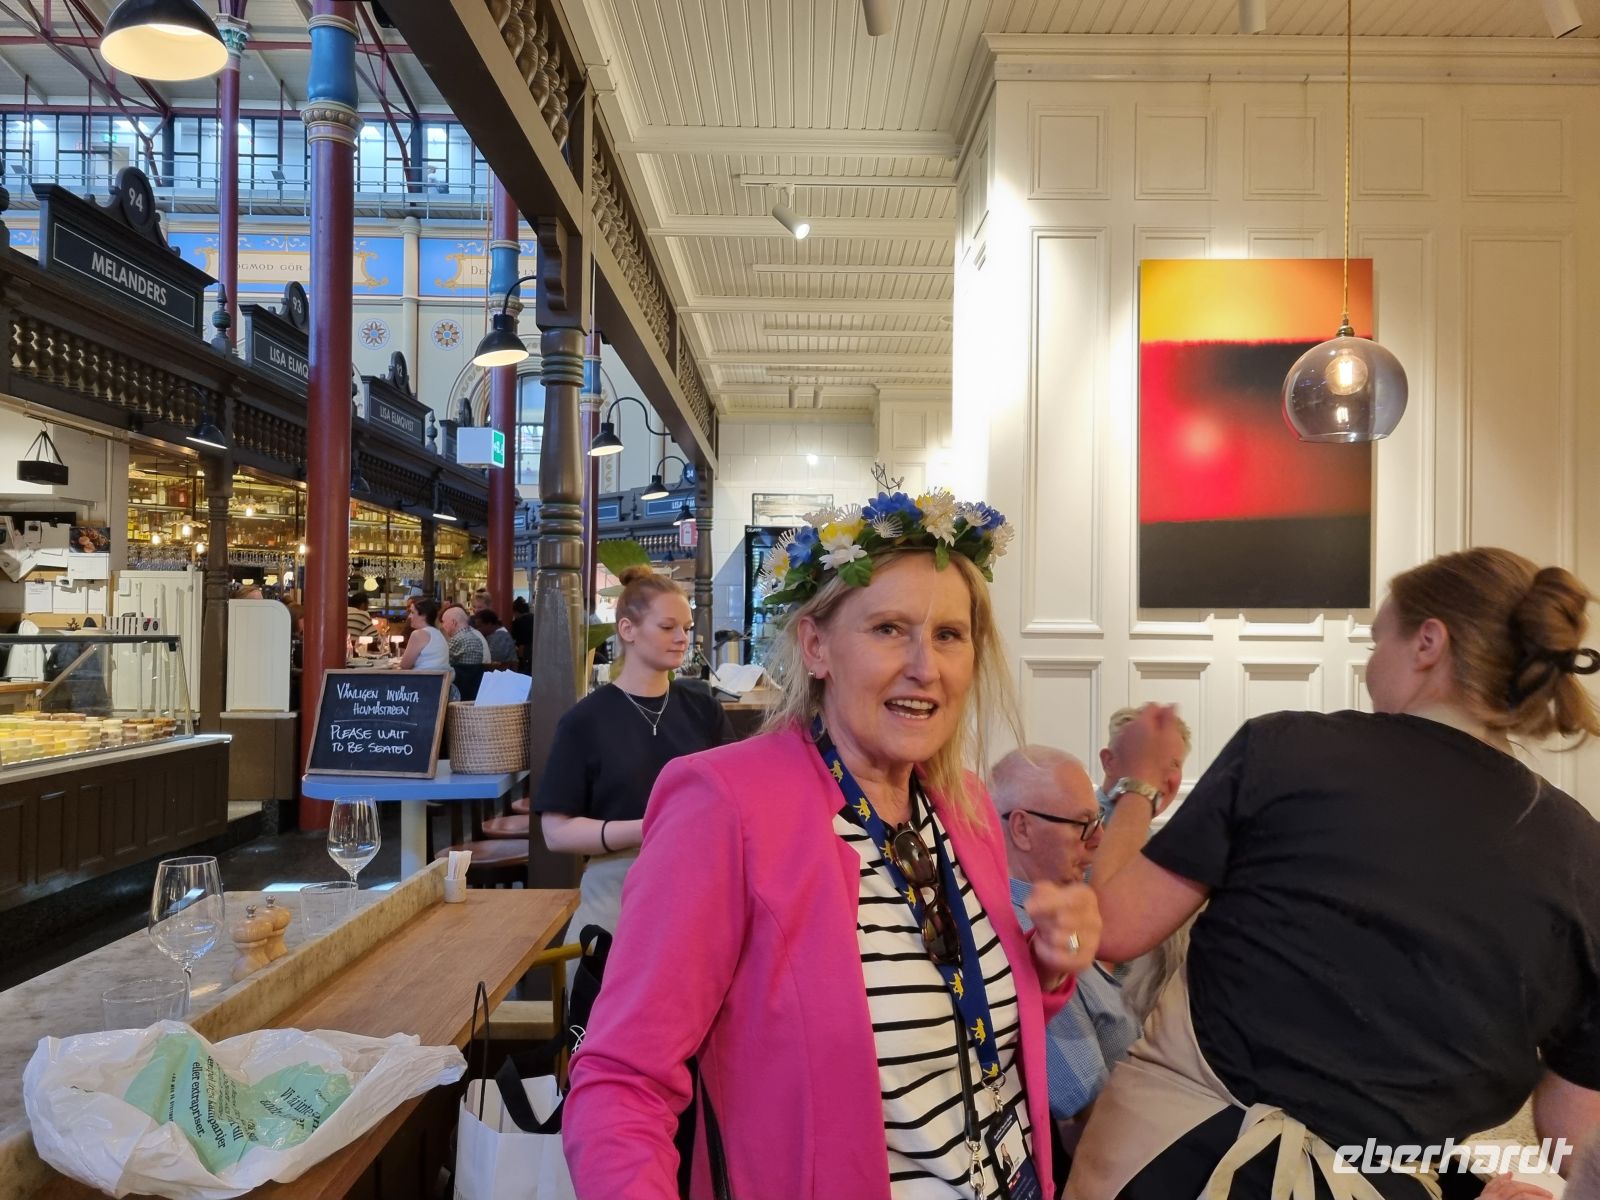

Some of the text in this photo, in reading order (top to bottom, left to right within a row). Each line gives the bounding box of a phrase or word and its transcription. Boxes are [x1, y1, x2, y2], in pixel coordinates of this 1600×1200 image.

[128, 187, 144, 212] 94
[91, 252, 167, 306] MELANDERS
[292, 296, 302, 314] 93
[269, 345, 309, 380] LISA ELMQ
[380, 405, 391, 421] LISA
[337, 682, 420, 703] VÄNLIGEN INVÄNTA
[331, 724, 409, 741] PLEASE WAIT
[332, 741, 413, 756] TO BE SEATED
[189, 1061, 206, 1139] eller extrapriser.
[280, 1087, 296, 1101] Vi
[294, 1099, 314, 1116] inte
